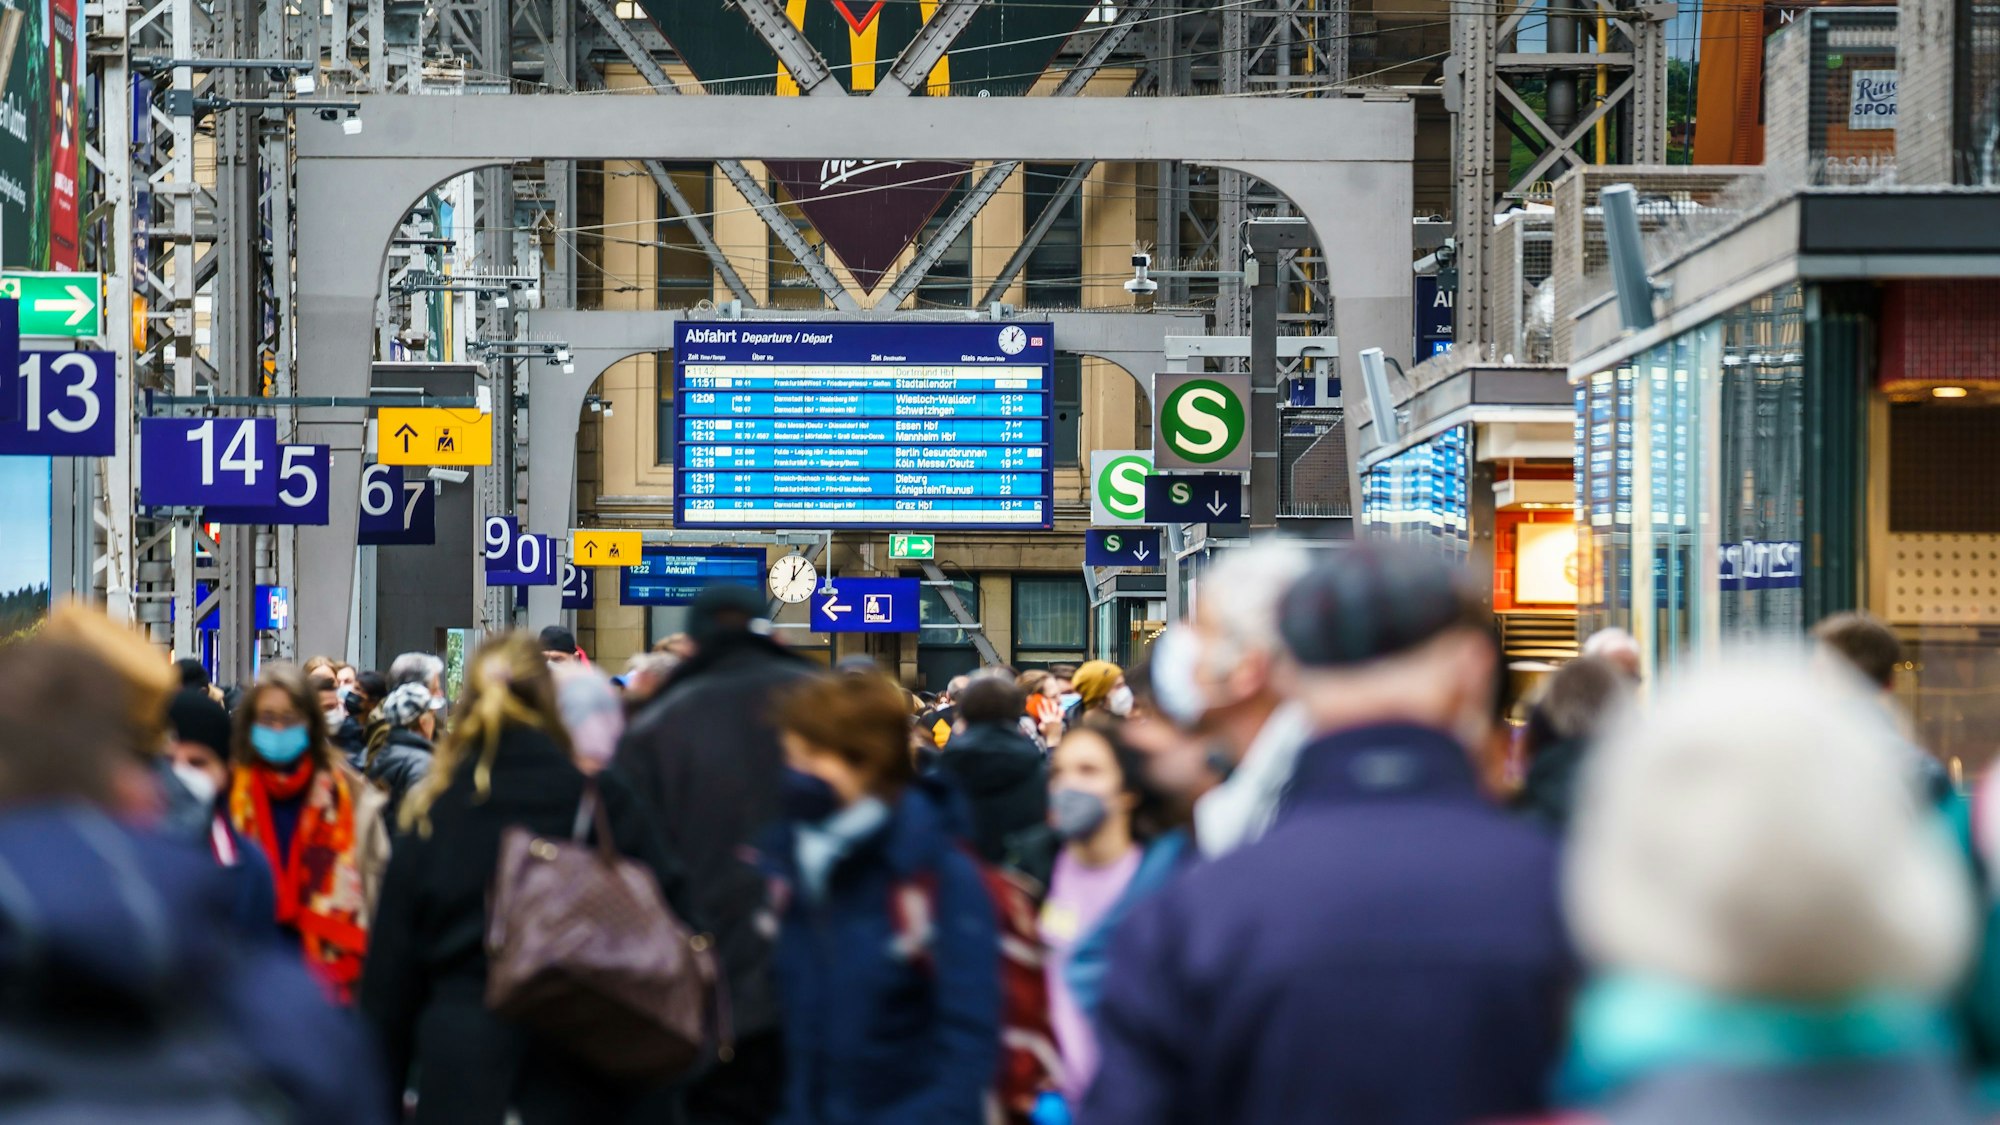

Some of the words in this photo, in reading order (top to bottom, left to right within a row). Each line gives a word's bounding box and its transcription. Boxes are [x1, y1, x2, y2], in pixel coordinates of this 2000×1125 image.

[1780, 9, 1794, 24] N
[1854, 103, 1897, 115] SPOR
[685, 329, 737, 343] Abfahrt
[741, 332, 792, 345] Departure
[801, 332, 833, 345] Départ
[752, 352, 766, 361] Über
[692, 378, 715, 388] 11:51
[895, 379, 957, 388] Stadtallendorf
[19, 353, 100, 432] 13
[896, 395, 976, 404] Wiesloch-Walldorf
[1000, 395, 1011, 404] 12
[896, 406, 955, 416] Schwetzingen
[1000, 406, 1011, 415] 12
[692, 420, 715, 430] 12:10
[896, 421, 921, 430] Essen
[924, 421, 939, 430] Hbf
[1005, 421, 1011, 430] 7
[1175, 388, 1229, 455] S
[692, 431, 715, 440] 12:12
[896, 432, 939, 441] Mannheim
[941, 432, 956, 441] Hbf
[1000, 432, 1011, 441] 17
[187, 419, 263, 485] 14
[692, 447, 715, 456] 12:14
[896, 448, 919, 457] Berlin
[923, 448, 987, 457] Gesundbrunnen
[896, 459, 914, 468] Köln
[917, 459, 974, 468] Messe/Deutz
[896, 474, 927, 484] Dieburg
[1000, 475, 1011, 483] 11
[692, 484, 715, 494] 12:17
[896, 485, 974, 496] Königstein(Taunus)
[1000, 485, 1011, 494] 22
[1109, 461, 1148, 514] S
[1172, 482, 1190, 504] S
[692, 499, 715, 509] 12:20
[896, 501, 915, 510] Graz
[918, 501, 932, 510] Hbf
[1000, 501, 1011, 510] 13
[1106, 535, 1120, 552] S
[630, 566, 649, 574] 12:22
[665, 566, 695, 574] Ankunft
